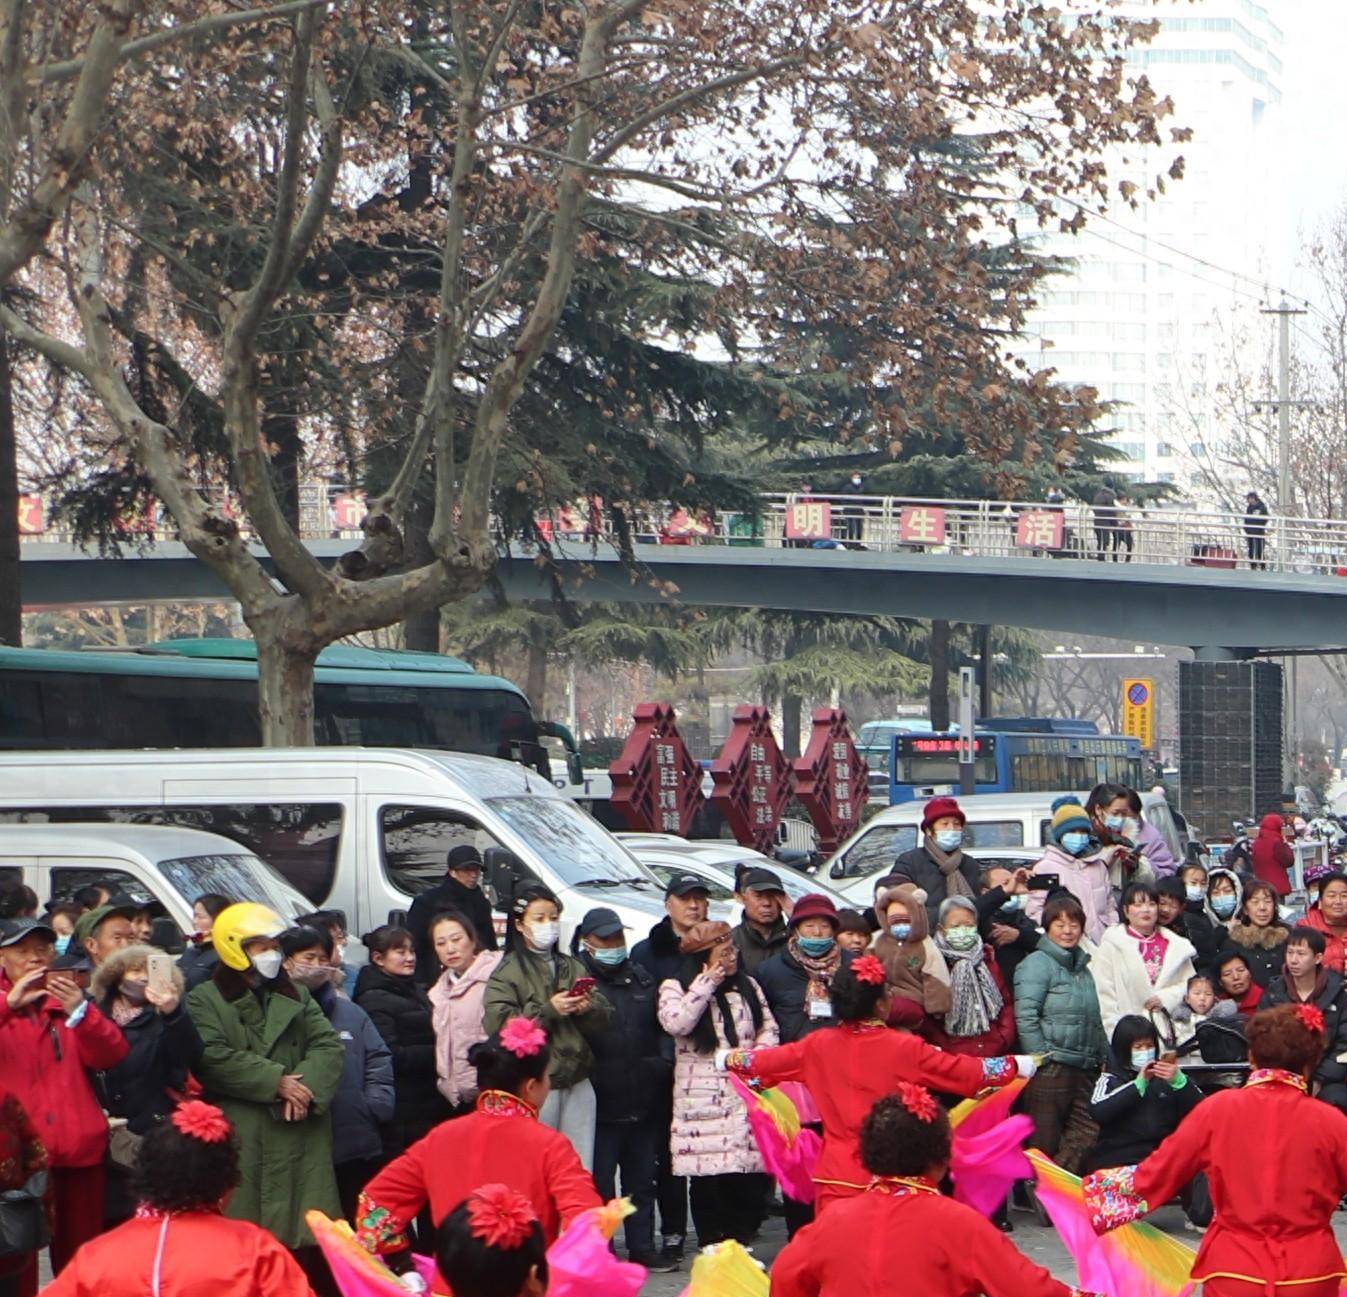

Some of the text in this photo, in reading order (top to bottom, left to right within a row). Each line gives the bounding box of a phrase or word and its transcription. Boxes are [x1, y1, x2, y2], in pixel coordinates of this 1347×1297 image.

[794, 504, 823, 537] 明
[907, 509, 938, 542] 生
[1025, 514, 1056, 546] 活
